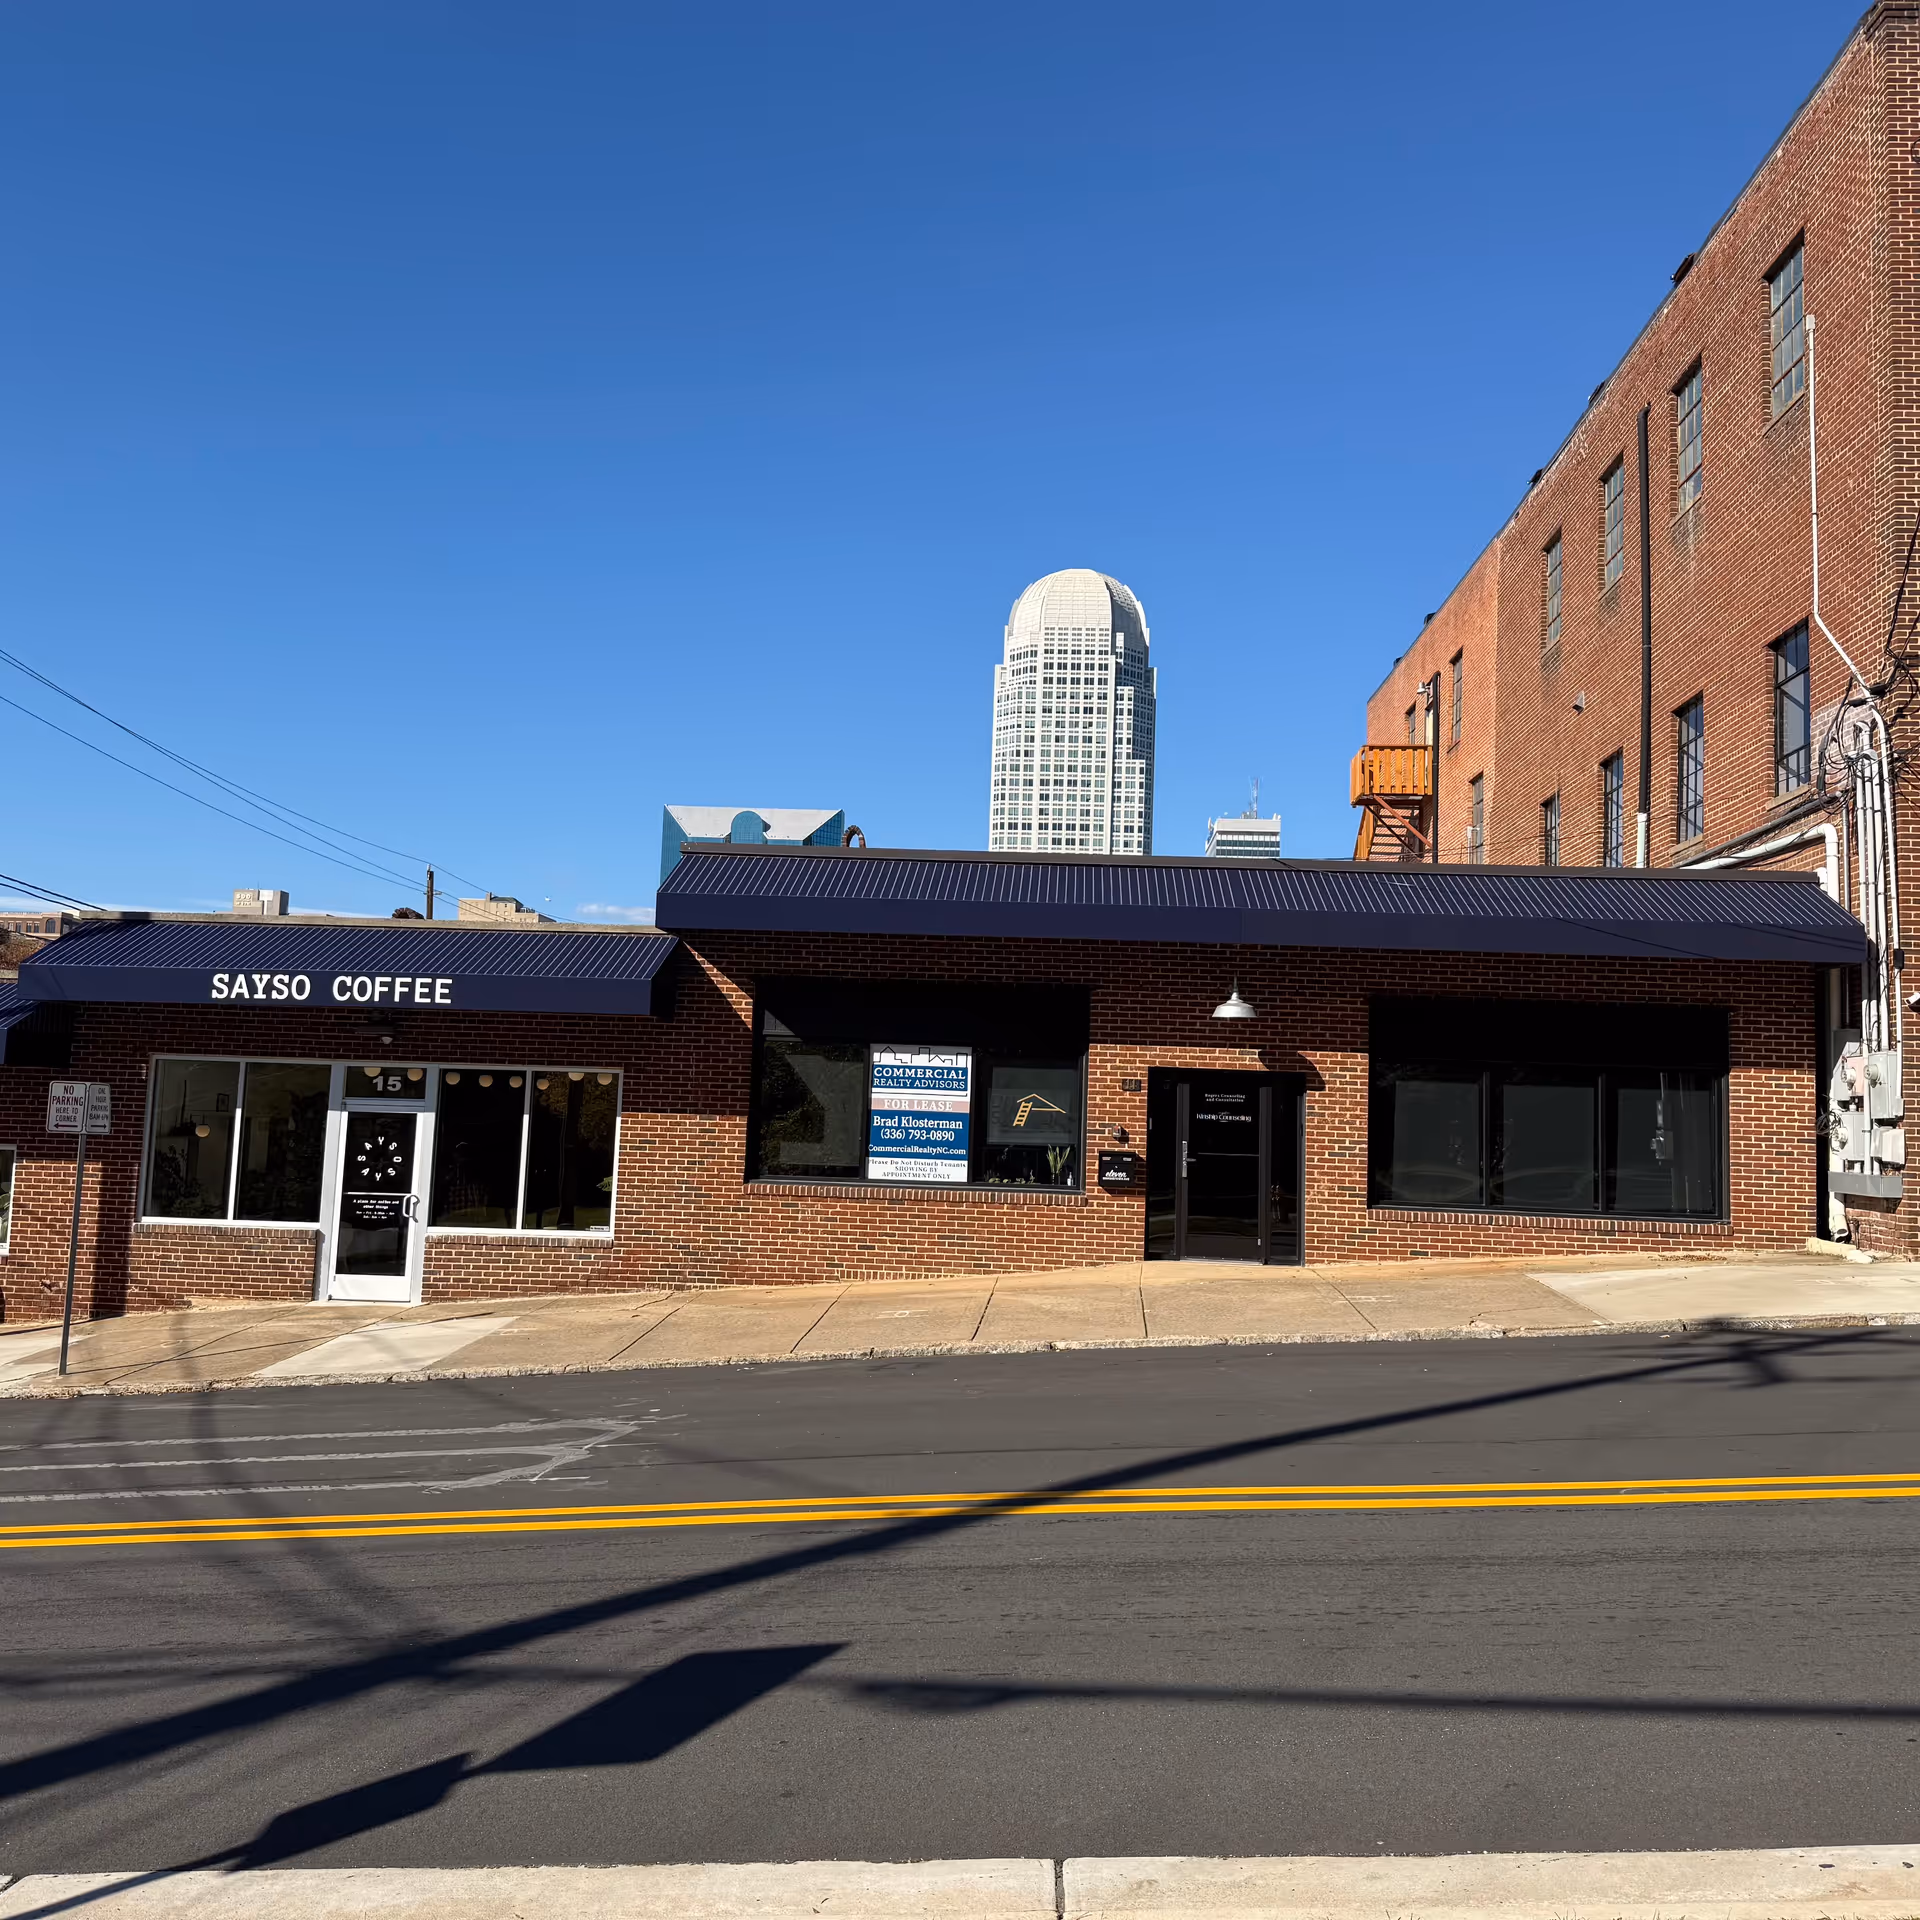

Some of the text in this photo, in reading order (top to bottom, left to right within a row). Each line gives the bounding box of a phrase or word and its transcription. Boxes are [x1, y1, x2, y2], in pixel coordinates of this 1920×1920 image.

[211, 973, 453, 1004] SAYSO COFFEE
[873, 1067, 966, 1080] COMMERCIAL
[372, 1075, 402, 1092] 15
[873, 1078, 965, 1089] REALTY ADVISORS
[63, 1085, 75, 1095] NO
[52, 1095, 84, 1106] PARKING
[883, 1099, 953, 1111] FOR LEASE
[72, 1107, 79, 1115] TO
[873, 1115, 963, 1130] Brad Klosterman
[880, 1128, 955, 1142] (336) 793-0890
[868, 1144, 967, 1156] CommercialRealtyNC.com
